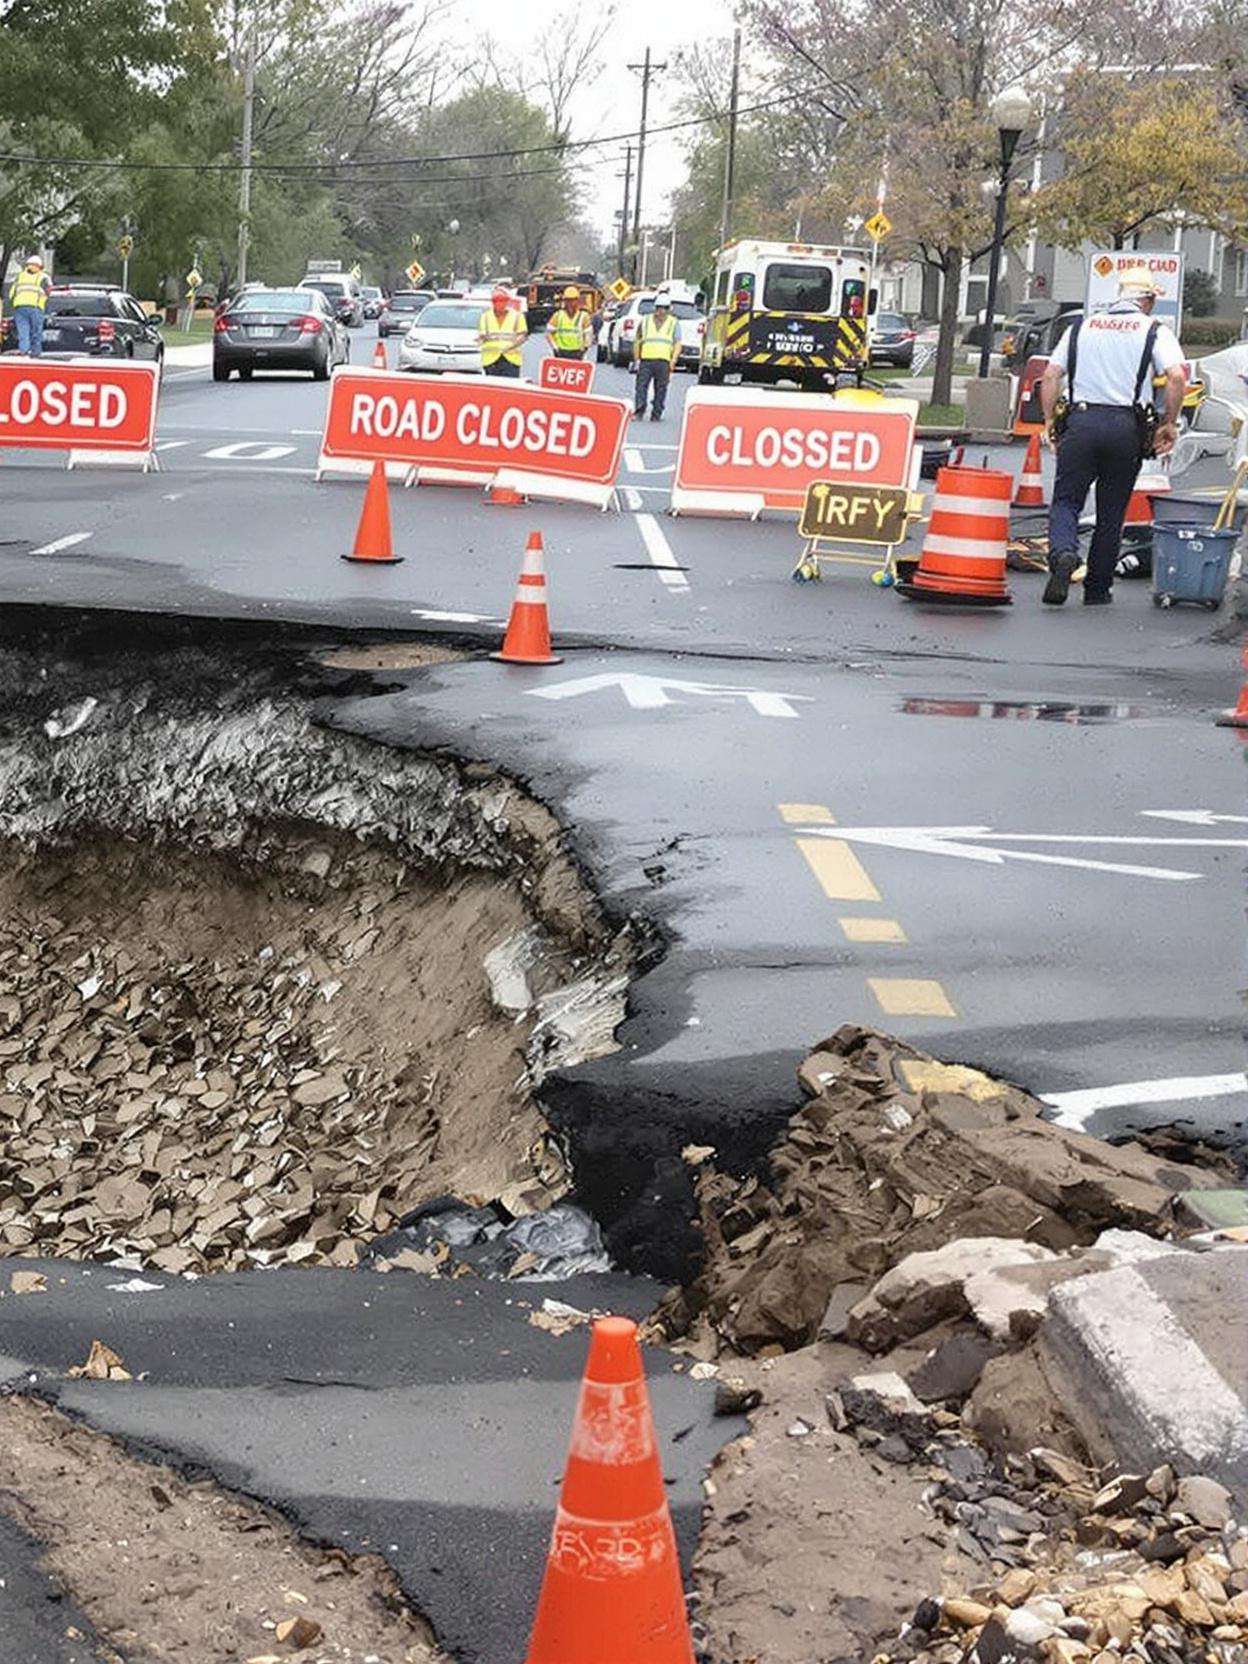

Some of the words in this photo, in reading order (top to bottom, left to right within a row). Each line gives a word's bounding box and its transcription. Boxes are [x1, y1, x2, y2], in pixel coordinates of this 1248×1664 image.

[351, 394, 445, 441] ROAD
[456, 403, 596, 457] CLOSED
[706, 424, 881, 472] CLOSSED
